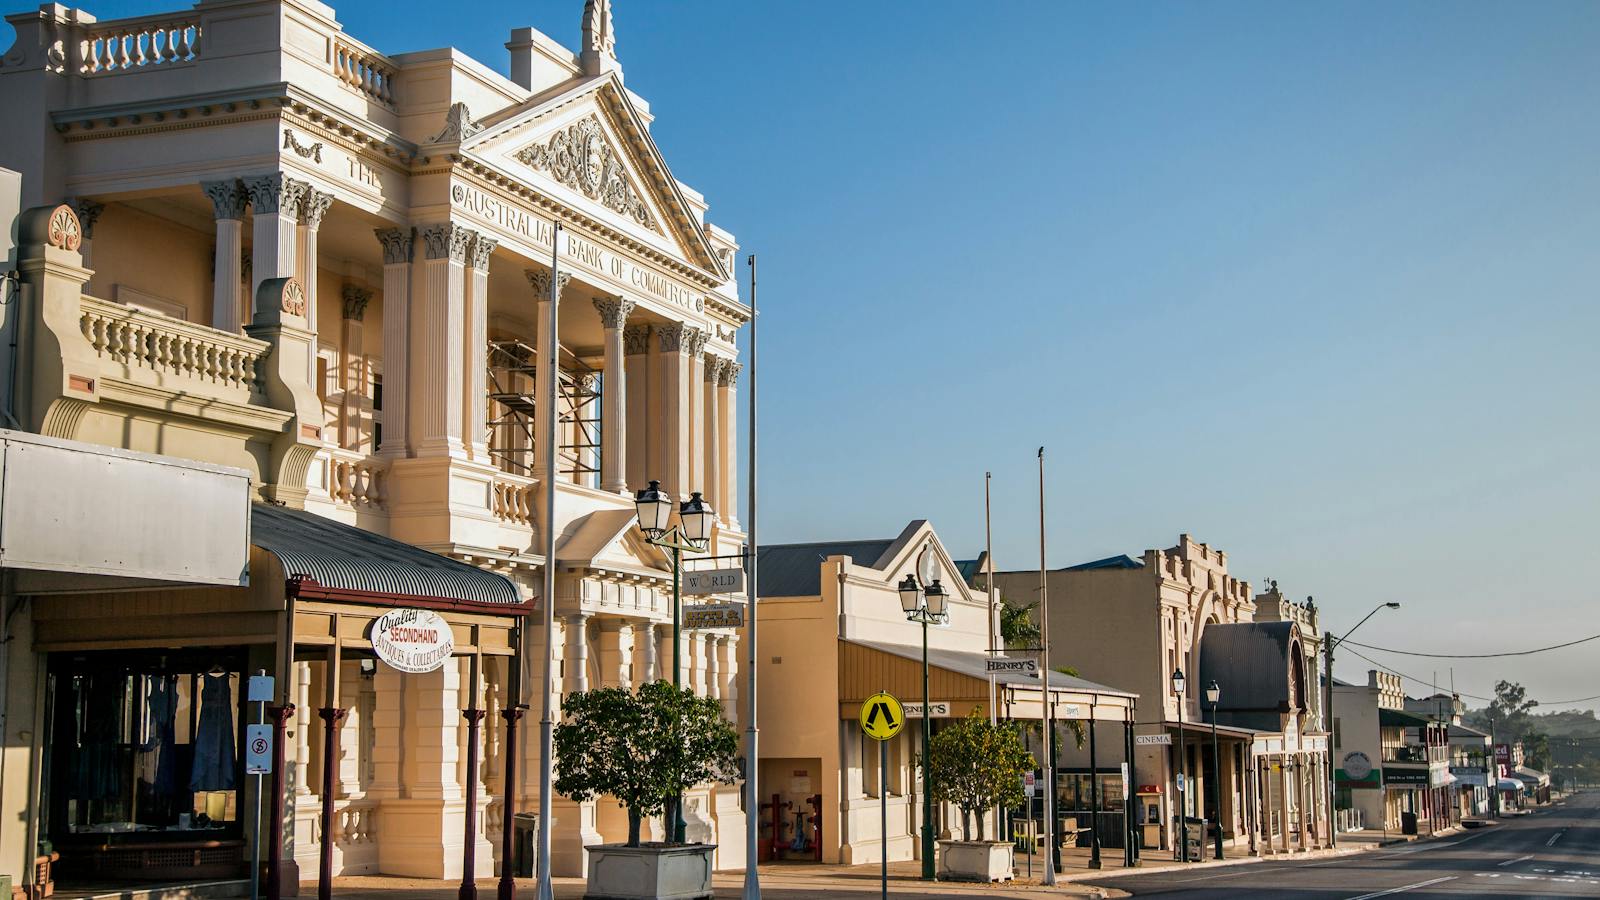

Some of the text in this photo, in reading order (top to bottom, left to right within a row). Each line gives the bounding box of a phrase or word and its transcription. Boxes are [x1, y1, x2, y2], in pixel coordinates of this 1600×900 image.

[347, 156, 383, 190] THE
[568, 235, 604, 271] BANK
[611, 256, 628, 279] OF
[631, 265, 695, 309] COMMERCE
[689, 574, 736, 588] WORLD
[380, 609, 418, 634] Quality
[390, 627, 438, 644] SECONDHAND
[376, 635, 405, 663] ANTIQUES
[413, 641, 452, 666] COLLECTABLES
[987, 660, 1035, 671] HENRY'S
[904, 704, 946, 714] ENY'S
[1136, 735, 1169, 744] CINEMA
